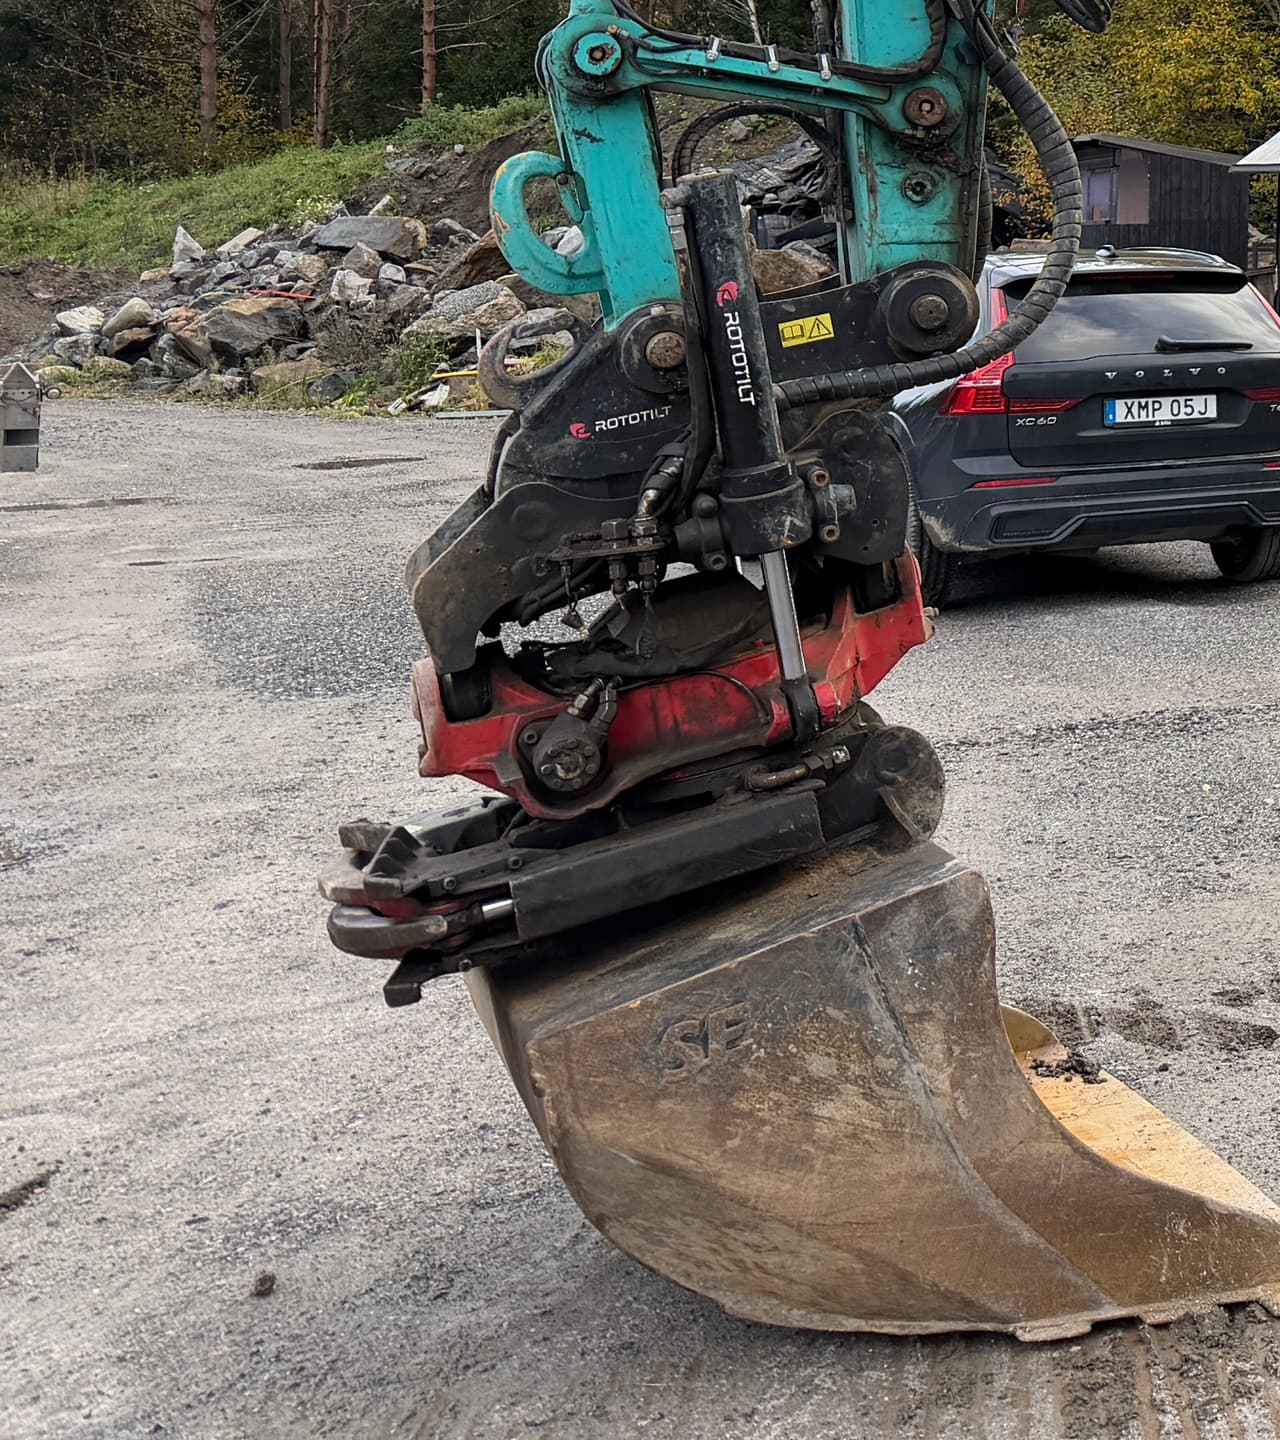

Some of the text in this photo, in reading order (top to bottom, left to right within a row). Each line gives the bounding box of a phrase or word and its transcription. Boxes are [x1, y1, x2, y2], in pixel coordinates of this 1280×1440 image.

[722, 311, 756, 407] ROTOTILT
[1105, 366, 1227, 380] VOLVO
[595, 405, 673, 432] ROTOTILT
[1124, 397, 1208, 420] XMP 05J
[1016, 416, 1057, 426] XC60
